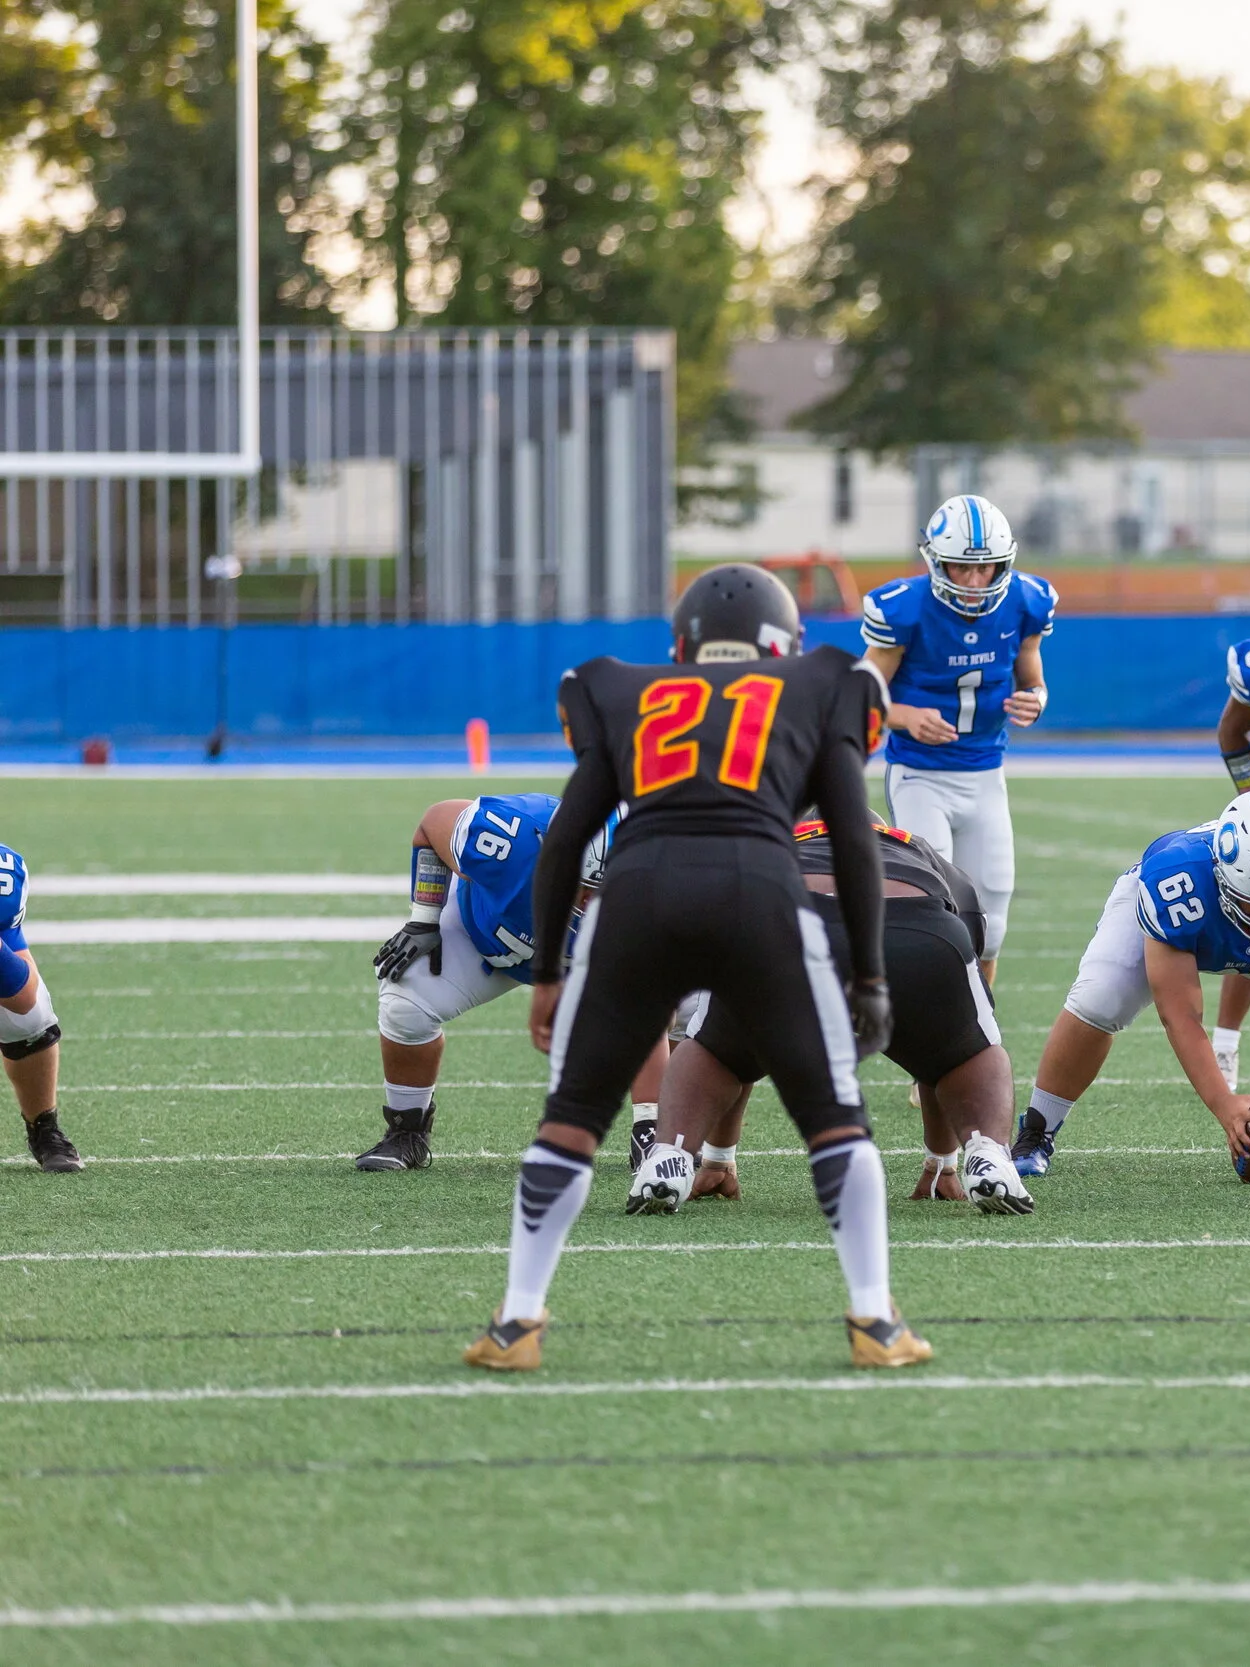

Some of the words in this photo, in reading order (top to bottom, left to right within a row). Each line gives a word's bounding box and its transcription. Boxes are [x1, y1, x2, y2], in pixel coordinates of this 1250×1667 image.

[948, 655, 968, 666] BLUE
[970, 651, 996, 665] DEVILS
[957, 669, 983, 734] 1
[633, 673, 785, 797] 21
[475, 810, 521, 861] 76
[1157, 871, 1205, 929] 62
[519, 932, 536, 945] BLU
